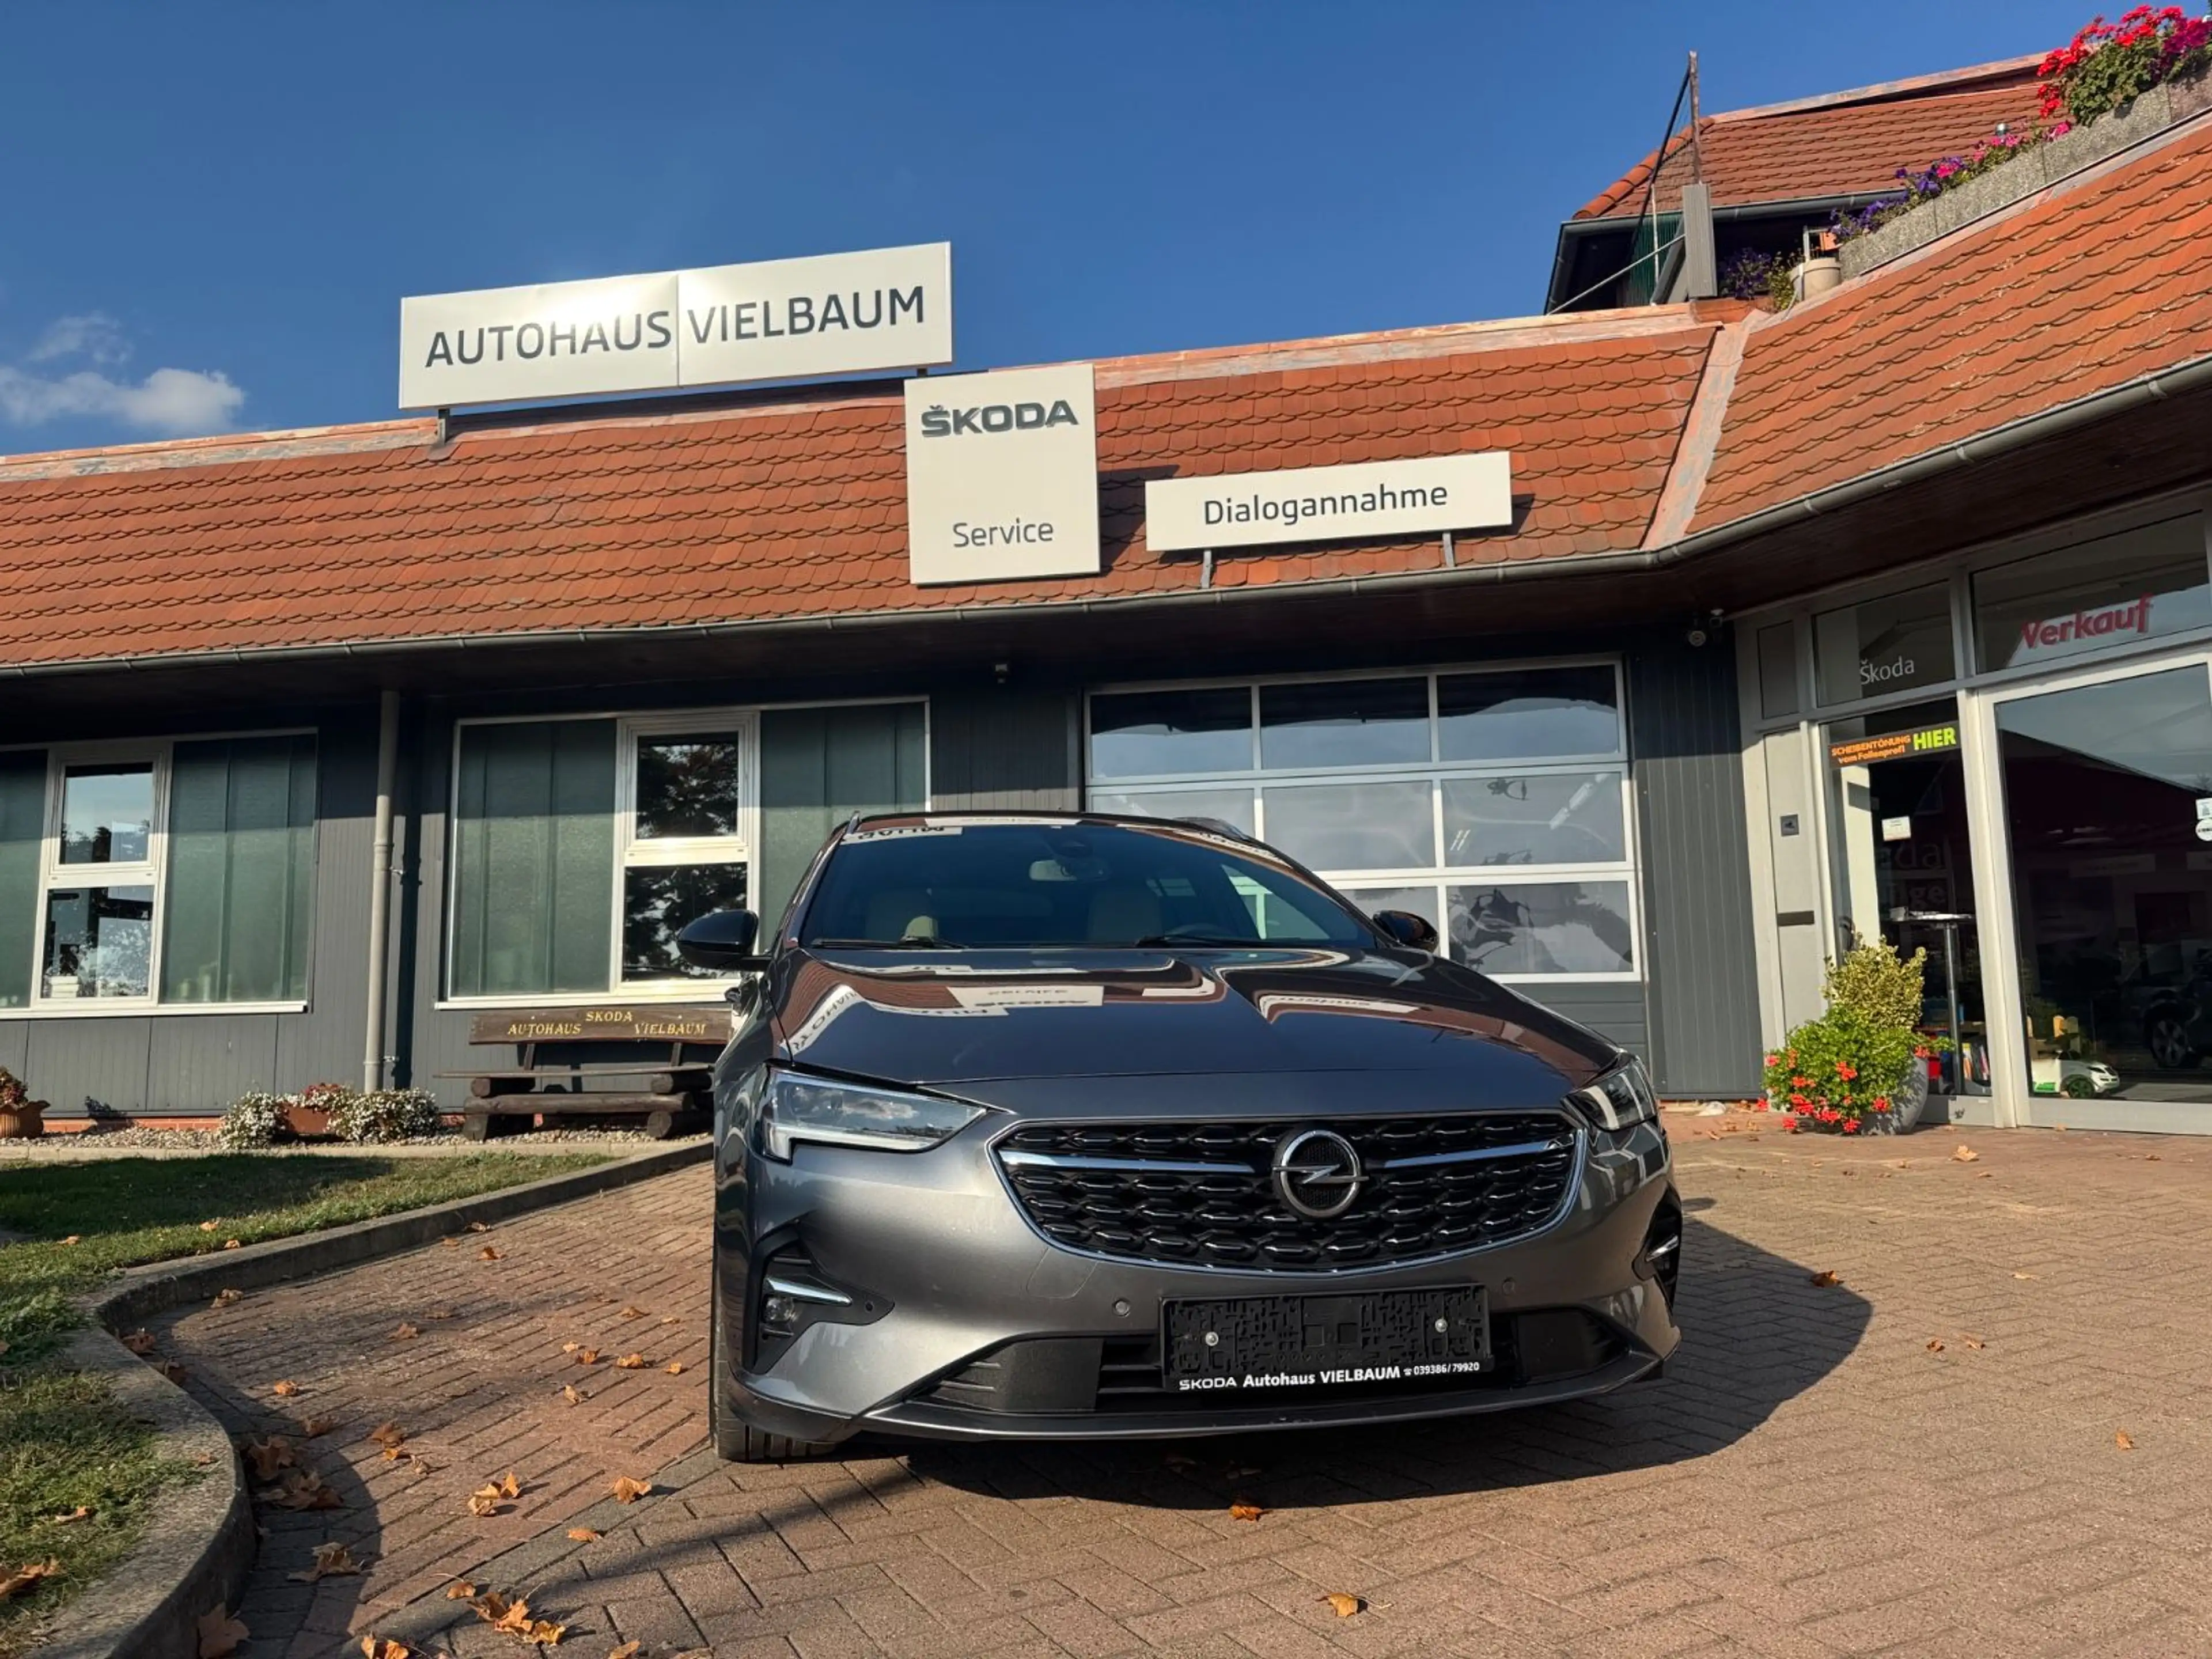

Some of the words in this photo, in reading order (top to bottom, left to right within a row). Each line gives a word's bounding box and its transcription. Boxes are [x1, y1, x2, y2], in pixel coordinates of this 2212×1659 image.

[425, 310, 671, 368] AUTOHAUS
[688, 286, 924, 344] VIELBAUM
[921, 399, 1079, 438] ŠKODA
[1204, 483, 1448, 525] Dialogannahme
[953, 517, 1054, 548] Service
[2021, 592, 2153, 649] Verkauf
[1859, 656, 1914, 685] Škoda
[1912, 727, 1956, 751] HIER
[507, 1023, 582, 1037] AUTOHAUS
[634, 1023, 707, 1036] VIELBAUM
[585, 1011, 633, 1022] SKODA
[1179, 1376, 1237, 1391] SKODA
[1243, 1372, 1316, 1388] Autohaus
[1320, 1366, 1401, 1383] VIELBAUM
